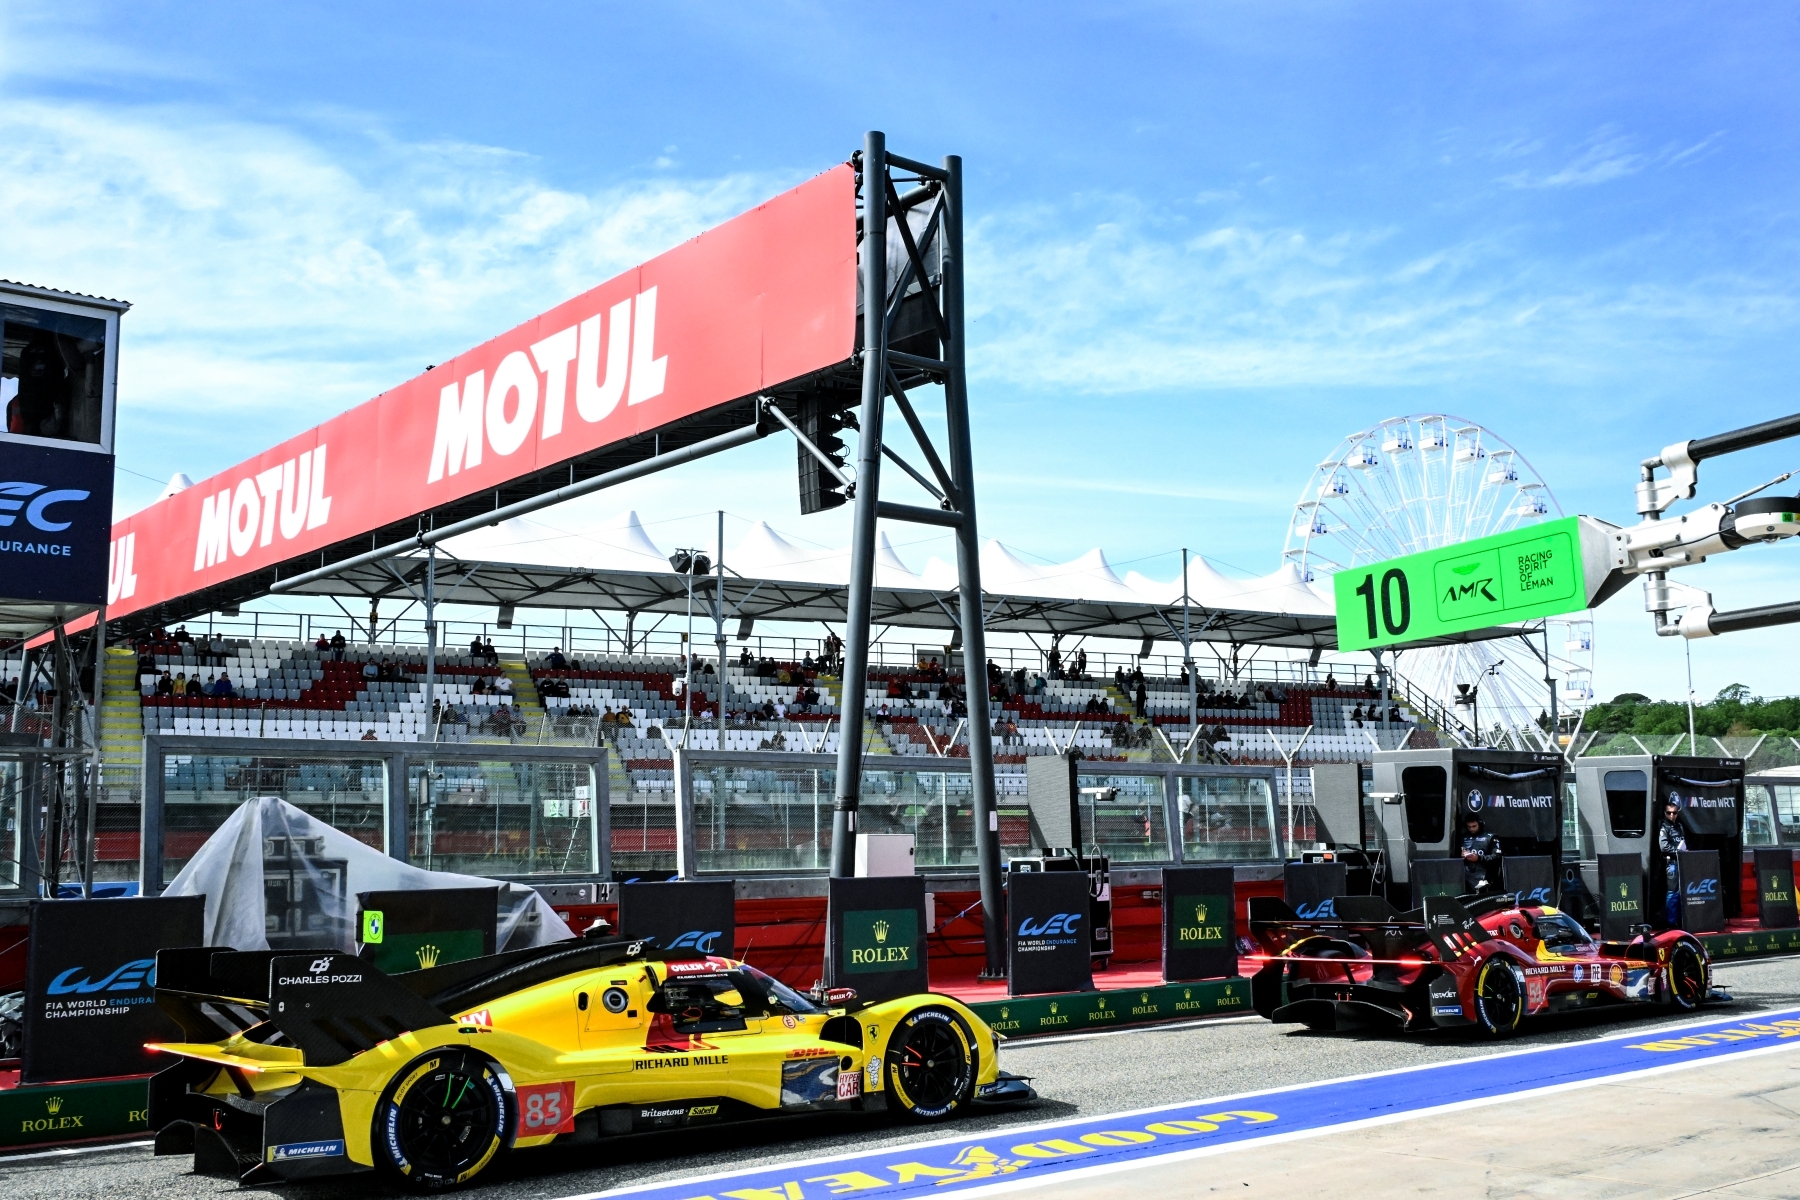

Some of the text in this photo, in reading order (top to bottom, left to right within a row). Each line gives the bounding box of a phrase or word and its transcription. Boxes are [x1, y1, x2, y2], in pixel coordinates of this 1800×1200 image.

[427, 285, 668, 485] MOTUL
[194, 443, 331, 572] MOTUL
[1517, 549, 1553, 566] RACING
[1518, 559, 1548, 574] SPIRIT
[1519, 571, 1533, 583] OF
[1442, 577, 1497, 604] AMR
[1520, 576, 1554, 592] LEMAN
[1356, 567, 1411, 640] 10
[1506, 795, 1529, 808] Team
[1529, 795, 1552, 808] WRT
[1699, 796, 1718, 808] Team
[1717, 796, 1736, 808] WRT
[1687, 878, 1718, 894] WEC
[1765, 891, 1788, 901] ROLEX
[1611, 900, 1639, 912] ROLEX
[1018, 913, 1082, 936] WEC
[1180, 926, 1222, 941] ROLEX
[851, 946, 909, 964] ROLEX
[670, 963, 704, 972] ORLEN
[1525, 965, 1566, 976] RICHARD MILLE
[46, 958, 156, 995] WE
[278, 974, 362, 986] CHARLES POZZI
[829, 993, 845, 1001] ORLEN
[1217, 996, 1241, 1006] ROLEX
[45, 997, 156, 1011] FIA WORLD ENDURA
[1132, 1004, 1158, 1015] ROLEX
[1175, 1000, 1200, 1011] ROLEX
[45, 1006, 131, 1019] CHAMPIONSHIP
[918, 1011, 950, 1022] MICHELIN
[1088, 1010, 1116, 1021] ROLEX
[991, 1020, 1020, 1031] ROLEX
[1040, 1015, 1069, 1026] ROLEX
[793, 1047, 830, 1058] DHL
[429, 1060, 437, 1070] M
[635, 1054, 729, 1070] RICHARD MILLE
[839, 1072, 860, 1083] HYPER
[839, 1081, 860, 1098] CAR
[492, 1083, 505, 1133] MICHELIN
[525, 1091, 562, 1128] 83
[21, 1115, 84, 1132] ROLEX
[387, 1108, 402, 1160] MICHELIN
[288, 1145, 337, 1155] MICHELIN
